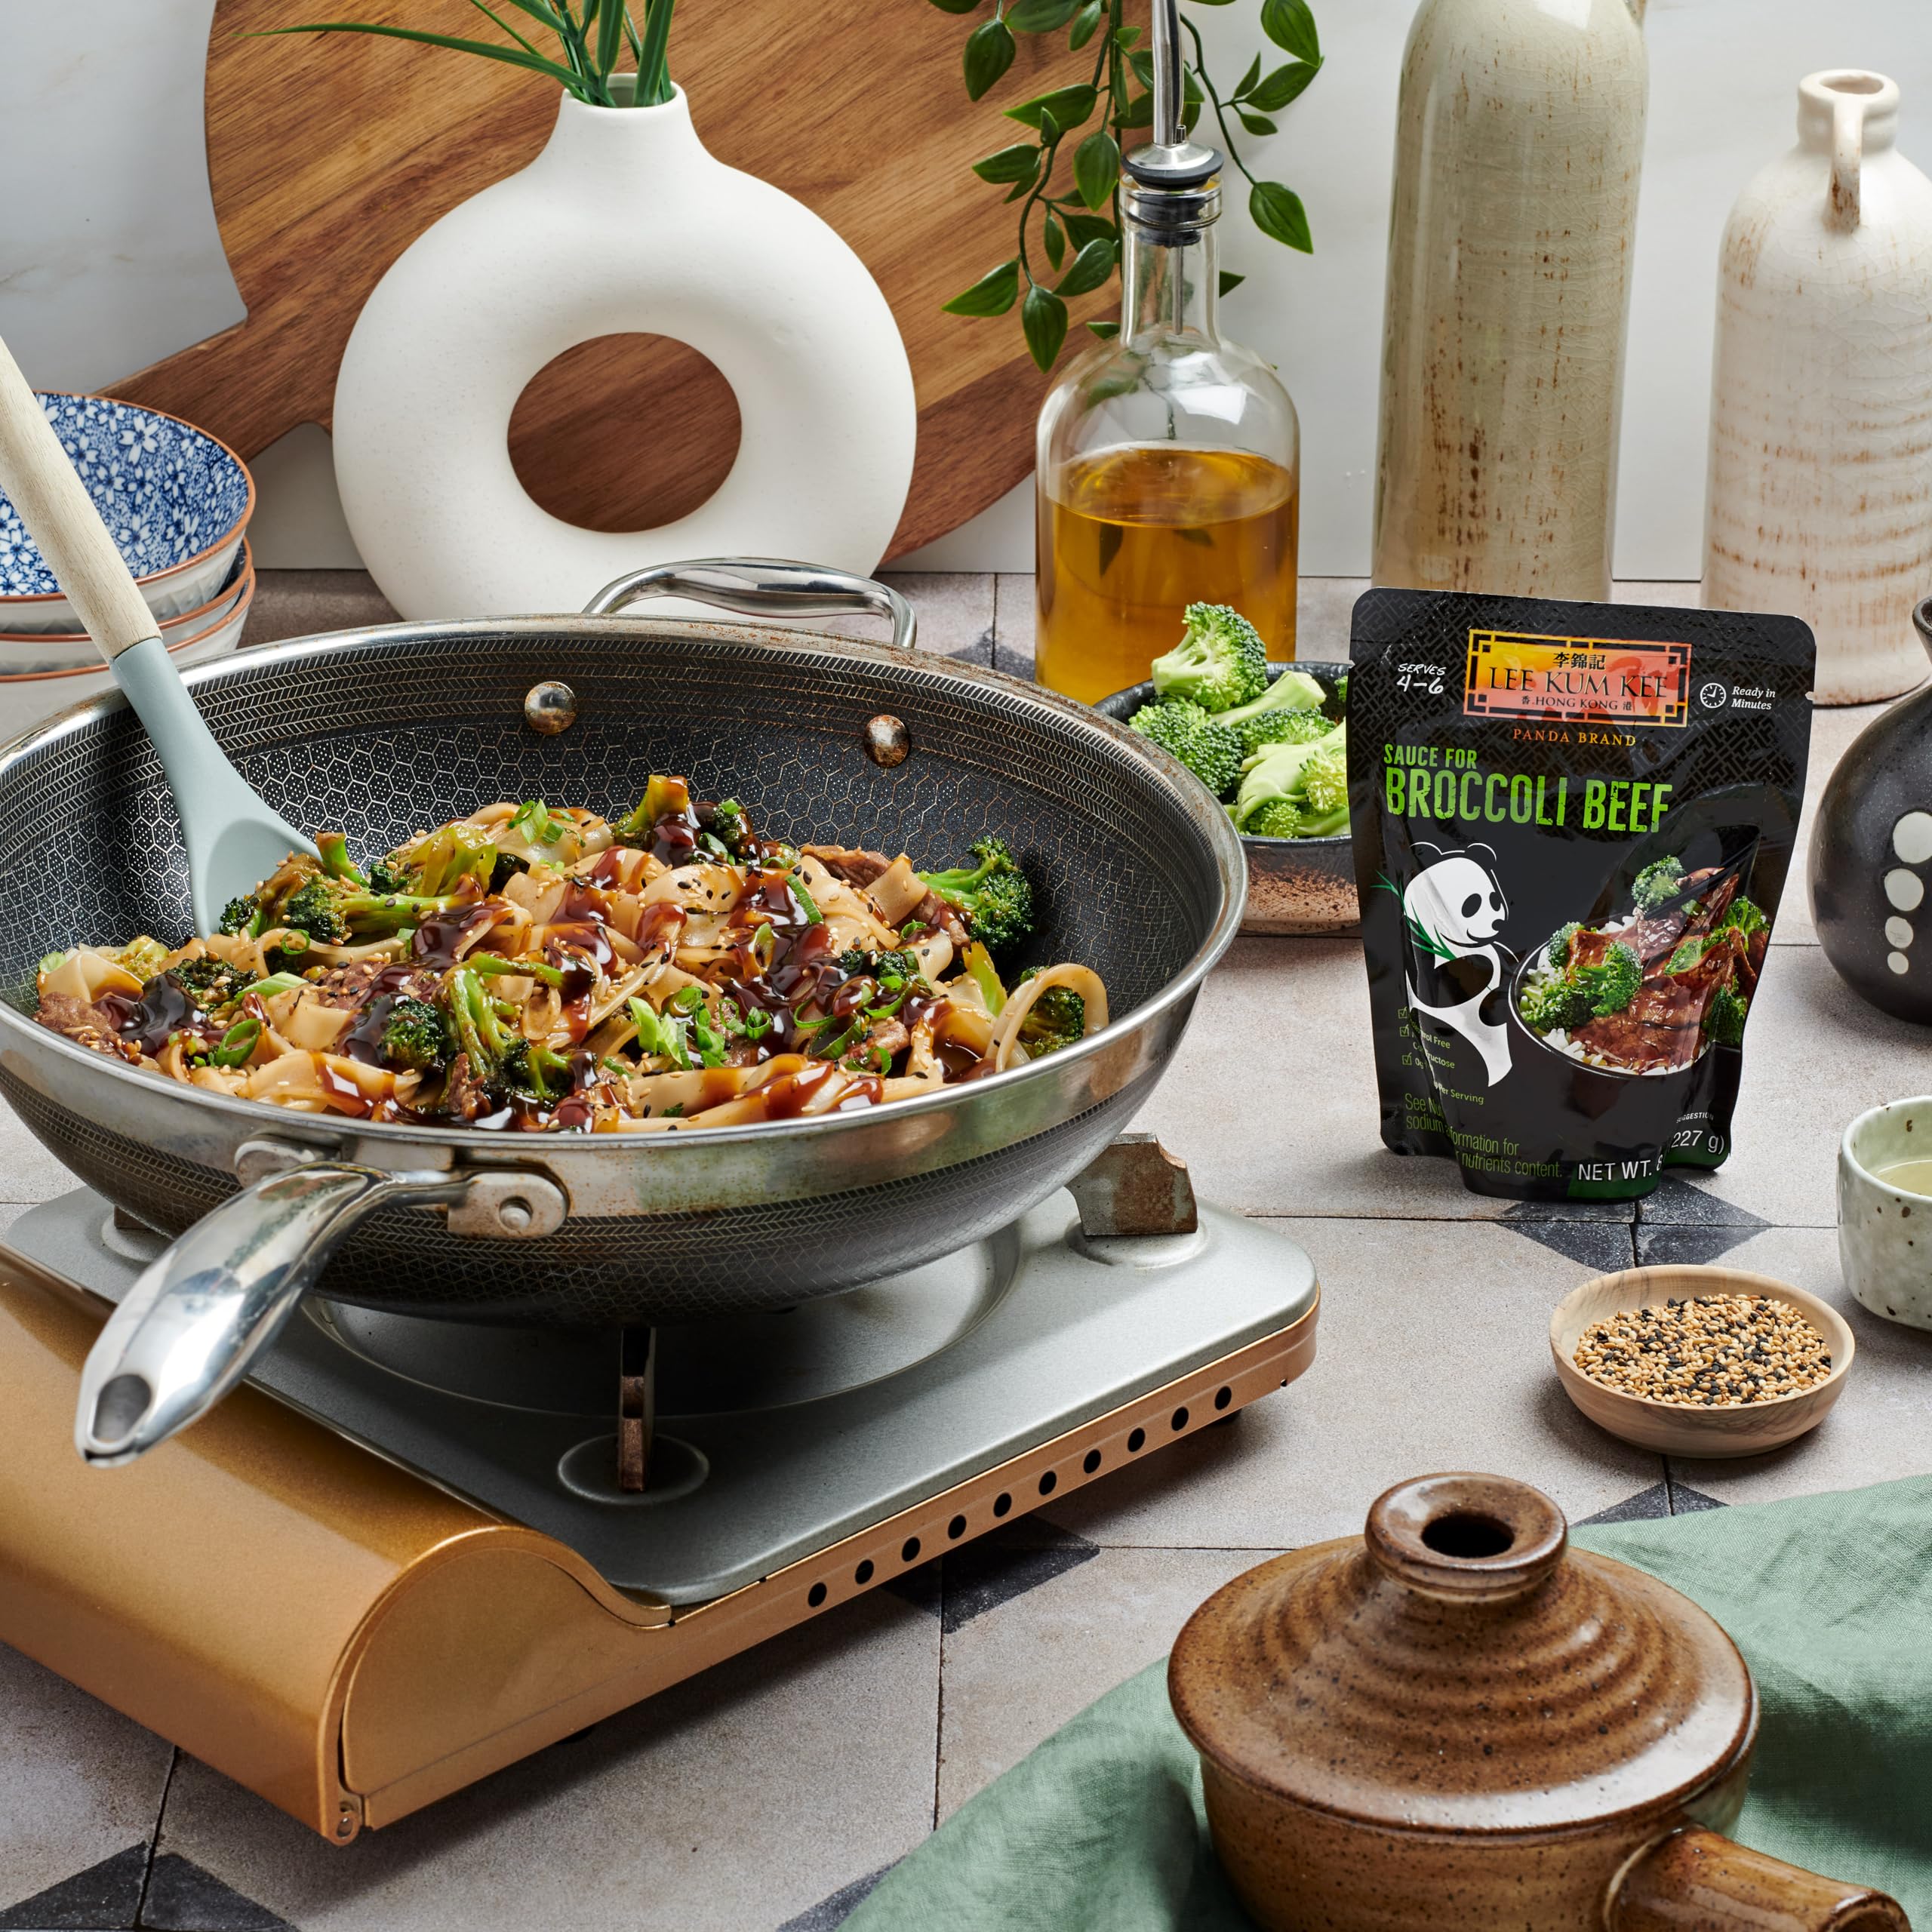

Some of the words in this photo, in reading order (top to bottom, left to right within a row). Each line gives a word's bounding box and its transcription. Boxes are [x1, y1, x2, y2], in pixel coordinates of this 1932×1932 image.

[1398, 663, 1447, 675] SERVES
[1553, 652, 1606, 670] 李錦記
[1396, 674, 1444, 694] 4-6
[1489, 667, 1534, 691] LEE
[1546, 672, 1608, 696] KUM
[1620, 675, 1667, 697] KEE
[1732, 686, 1764, 699] Ready
[1765, 688, 1776, 698] in
[1521, 696, 1531, 705] 香
[1536, 697, 1576, 708] HONG
[1580, 699, 1618, 710] KONG
[1731, 698, 1772, 710] Minutes
[1513, 729, 1570, 743] PANDA
[1579, 732, 1636, 746] BRAND
[1383, 743, 1439, 768] SAUCE
[1445, 748, 1478, 769] FOR
[1386, 767, 1568, 826] BROCCOLI
[1583, 779, 1673, 833] BEEF
[1434, 1036, 1451, 1049] Free
[1405, 1093, 1426, 1112] See
[1451, 1089, 1484, 1105] Serving
[1406, 1114, 1443, 1133] sodium
[1447, 1126, 1499, 1154] formation
[1503, 1137, 1520, 1156] for
[1708, 1134, 1724, 1155] g)
[1462, 1152, 1511, 1174] nutrients
[1515, 1161, 1562, 1177] content.
[1578, 1163, 1616, 1180] NET
[1621, 1160, 1652, 1180] WT.
